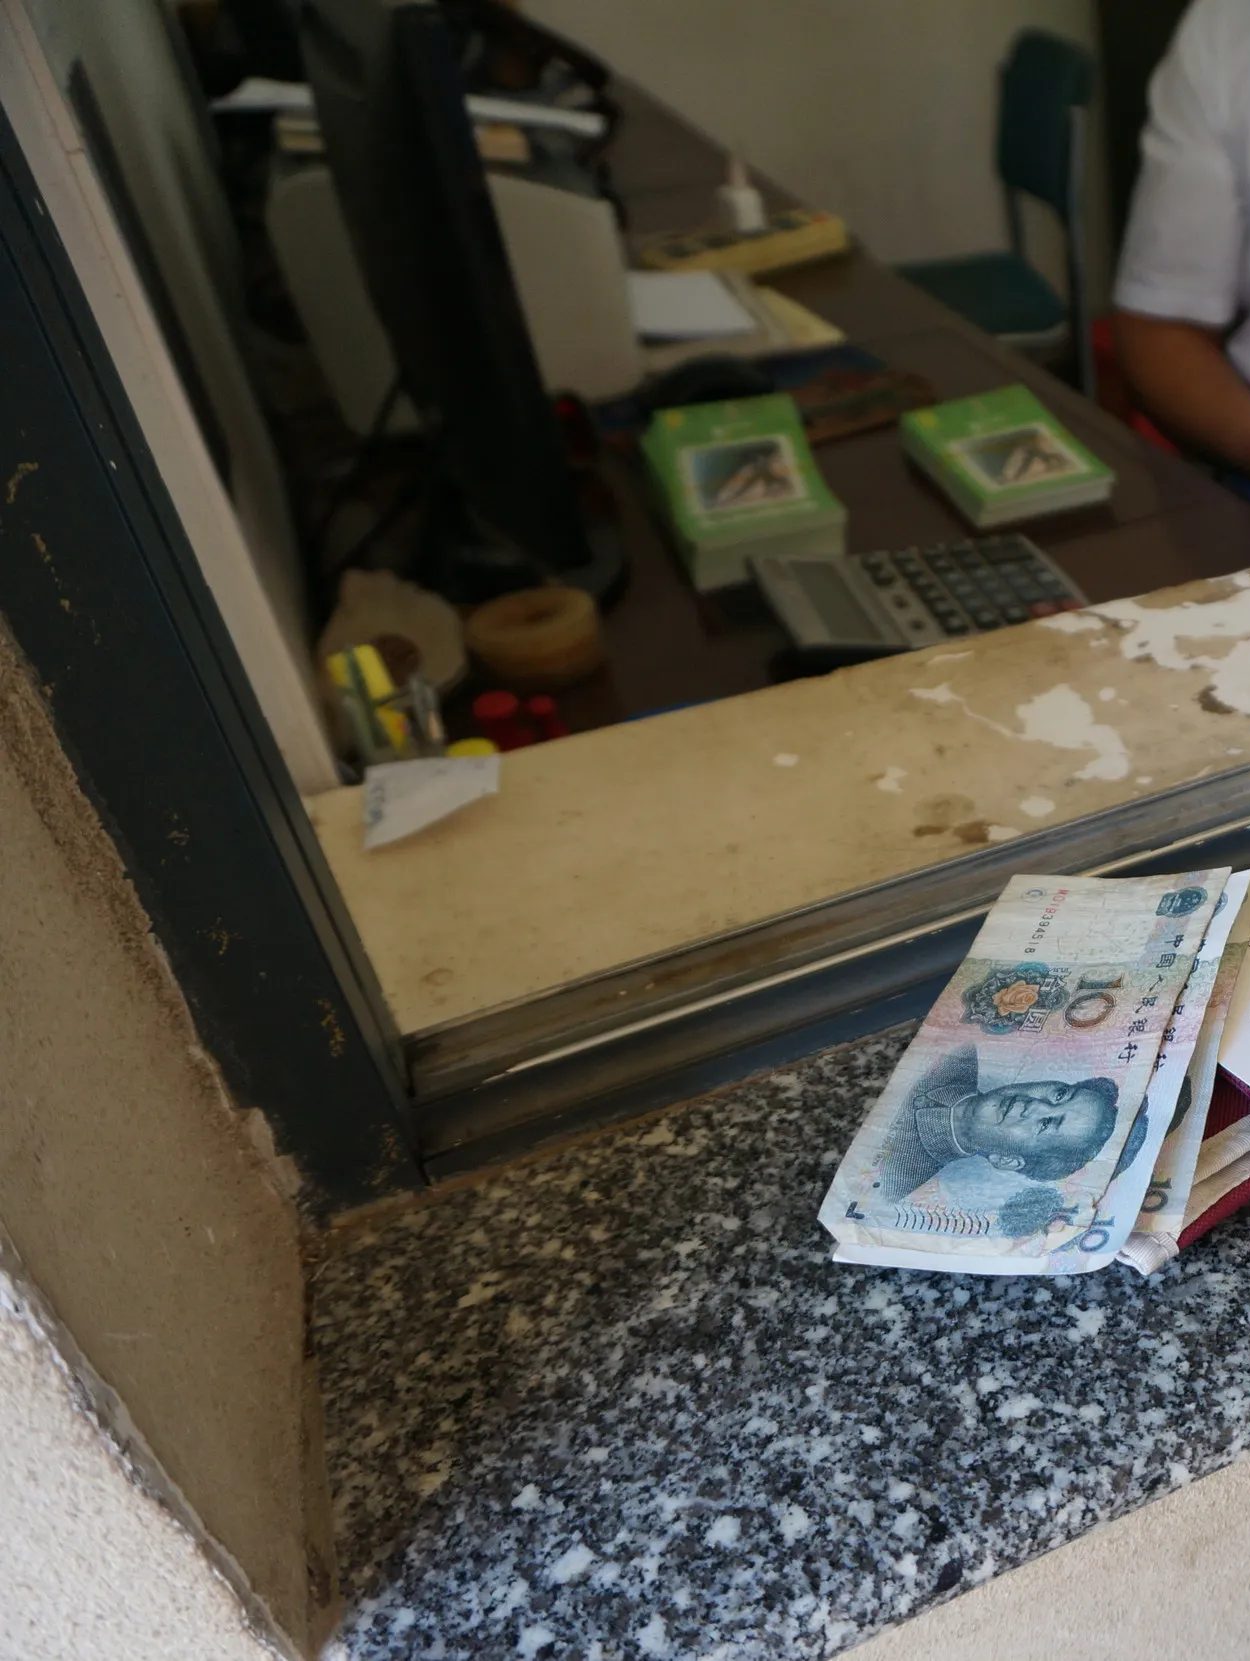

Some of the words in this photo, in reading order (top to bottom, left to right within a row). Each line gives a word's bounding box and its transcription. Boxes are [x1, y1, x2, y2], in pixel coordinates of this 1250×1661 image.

[1063, 972, 1125, 1030] 10
[1117, 934, 1184, 1064] 中国人民银行
[1141, 1177, 1172, 1213] 10
[1080, 1216, 1115, 1252] 10
